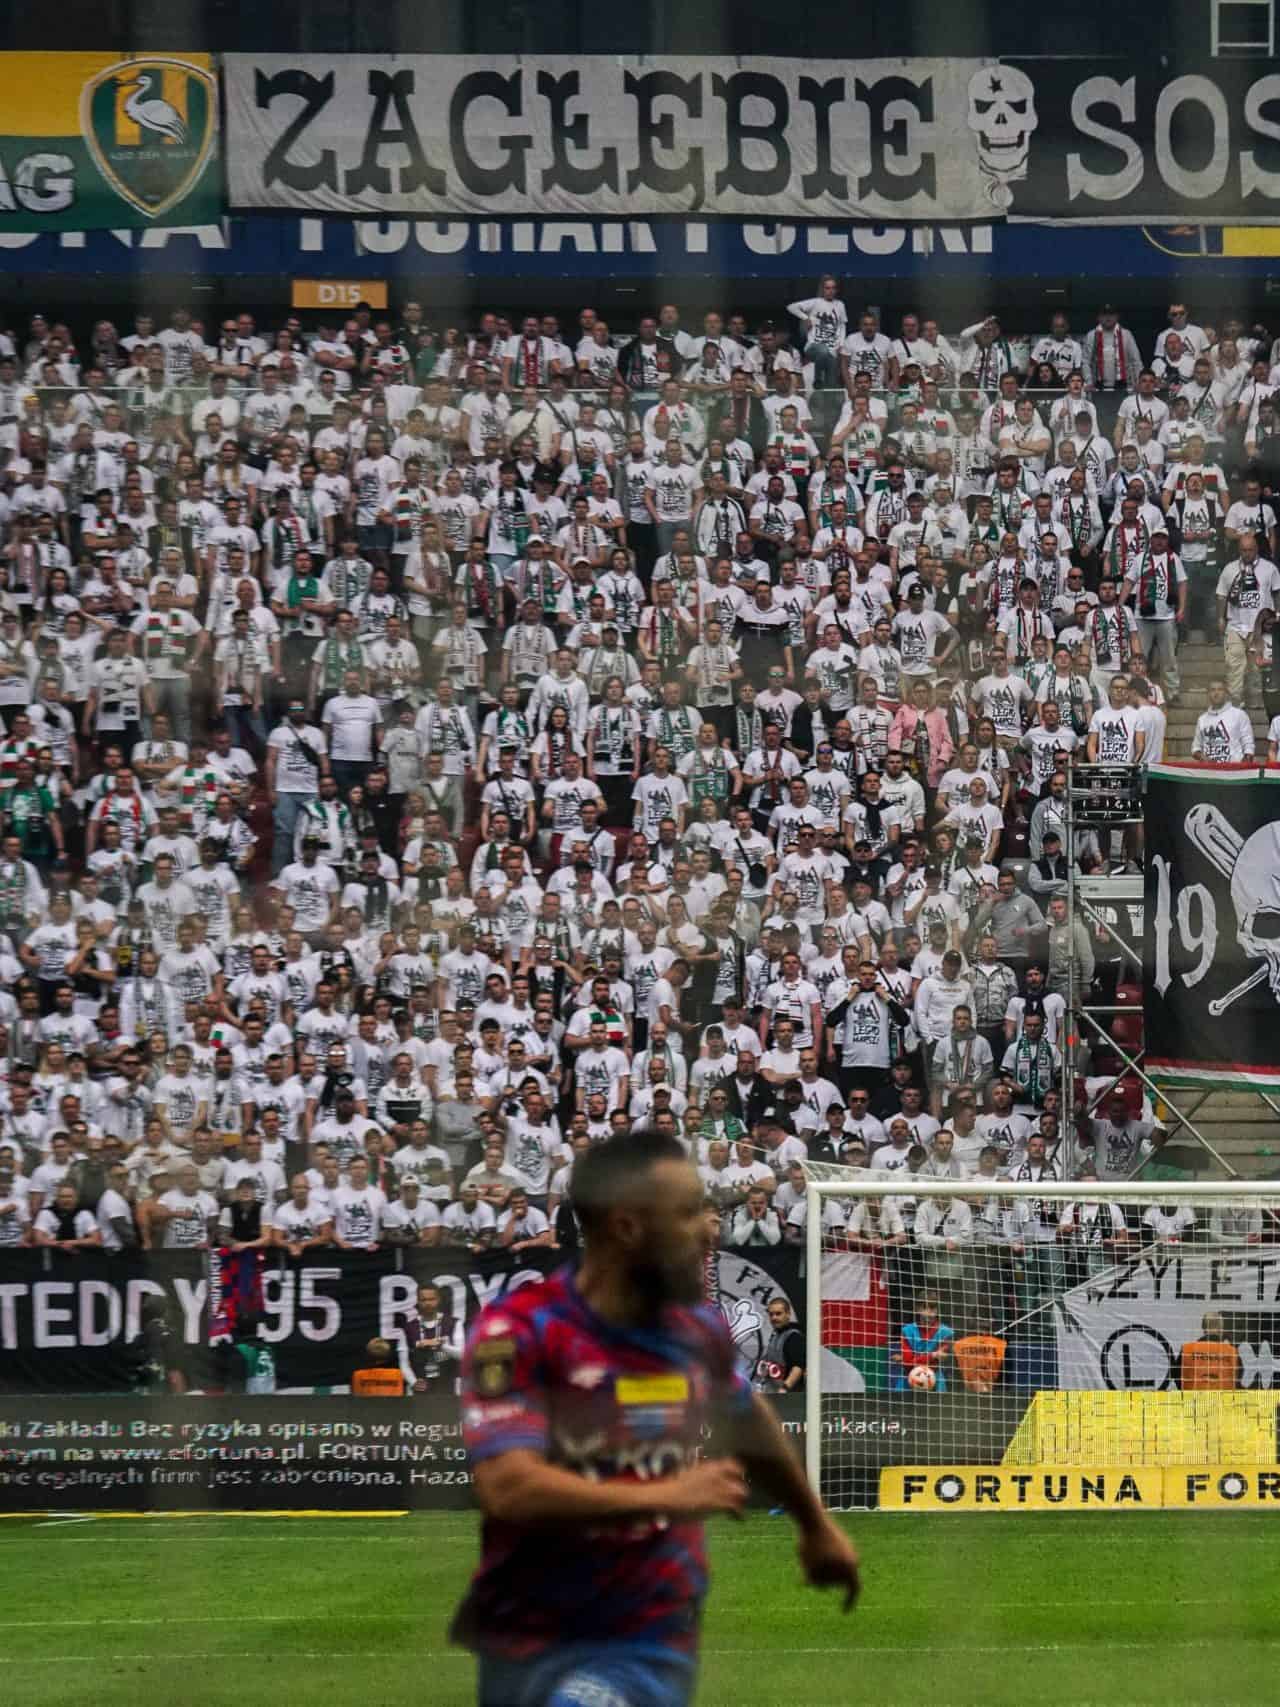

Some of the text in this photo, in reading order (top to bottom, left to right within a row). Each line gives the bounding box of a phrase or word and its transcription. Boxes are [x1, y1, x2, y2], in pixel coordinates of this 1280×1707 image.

[319, 284, 361, 303] D15
[1152, 854, 1218, 999] 19
[257, 1267, 342, 1342] 95
[379, 1270, 545, 1341] BOY
[1122, 1344, 1155, 1388] L
[130, 1420, 174, 1438] Bez
[180, 1420, 261, 1441] ryzyka
[268, 1420, 365, 1441] opisano
[371, 1424, 392, 1438] w
[64, 1447, 94, 1461] na
[318, 1443, 438, 1461] FORTUNA
[444, 1446, 467, 1461] to
[902, 1473, 1143, 1505] FORTUNA
